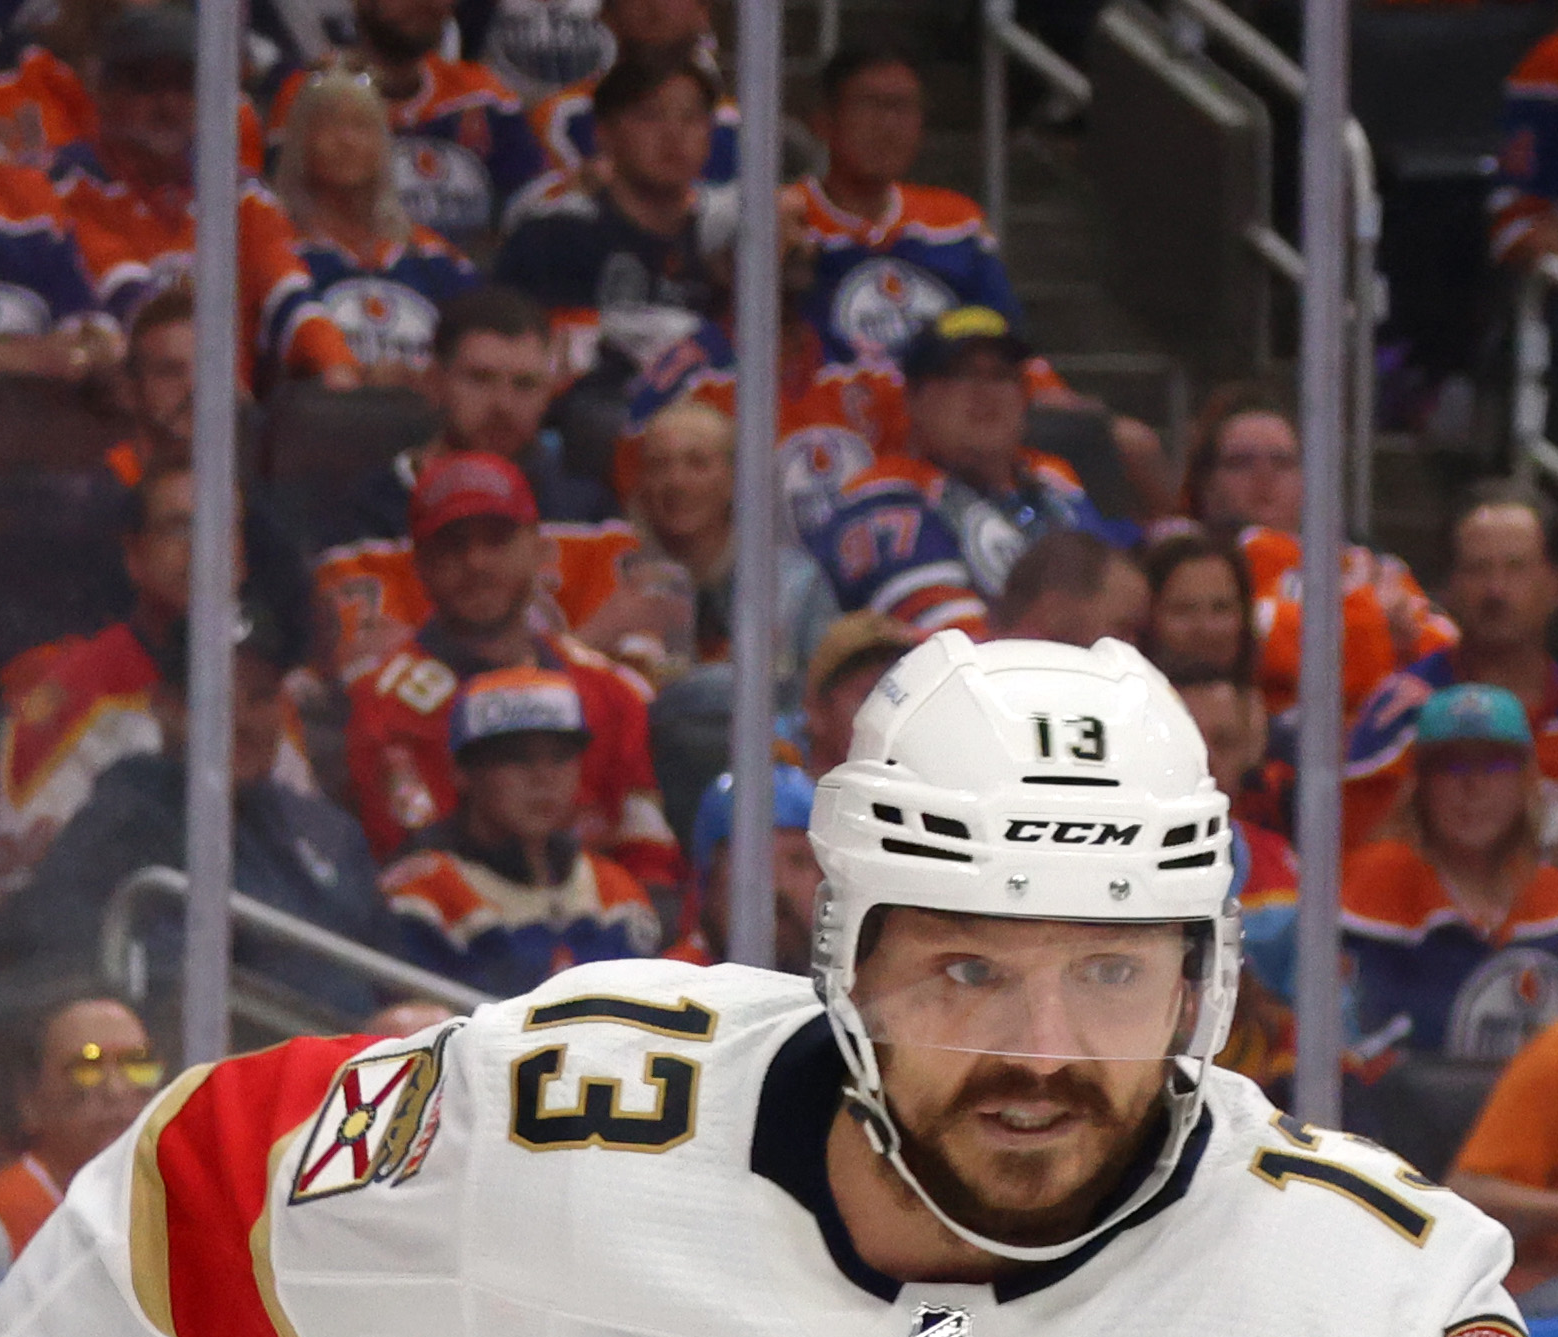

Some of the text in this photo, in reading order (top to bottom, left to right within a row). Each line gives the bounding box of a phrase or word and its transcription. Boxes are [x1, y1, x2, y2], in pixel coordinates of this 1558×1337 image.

[1029, 711, 1108, 767] 13
[1003, 819, 1144, 847] CCM
[508, 996, 720, 1154] 13
